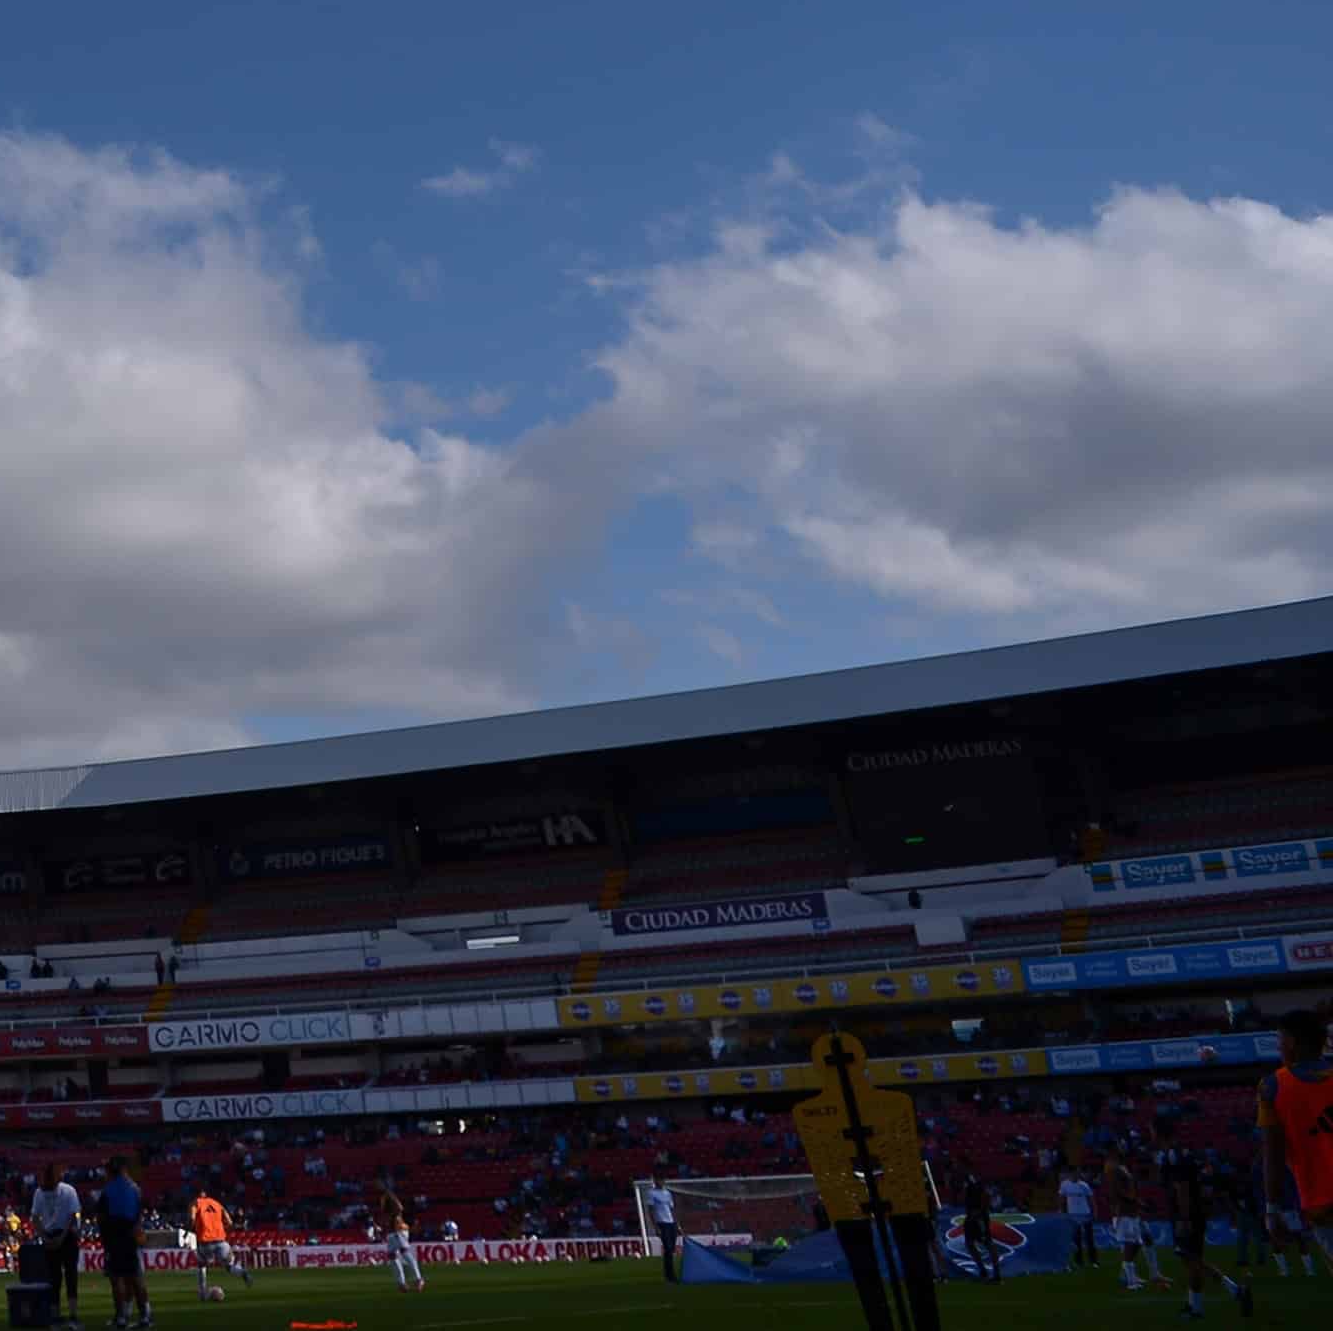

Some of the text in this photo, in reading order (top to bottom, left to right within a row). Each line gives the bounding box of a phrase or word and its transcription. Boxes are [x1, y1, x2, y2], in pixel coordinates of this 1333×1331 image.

[624, 899, 813, 931] CIUDAD MADERAS
[269, 1017, 344, 1041] CLICK
[283, 1092, 351, 1115] CLICK
